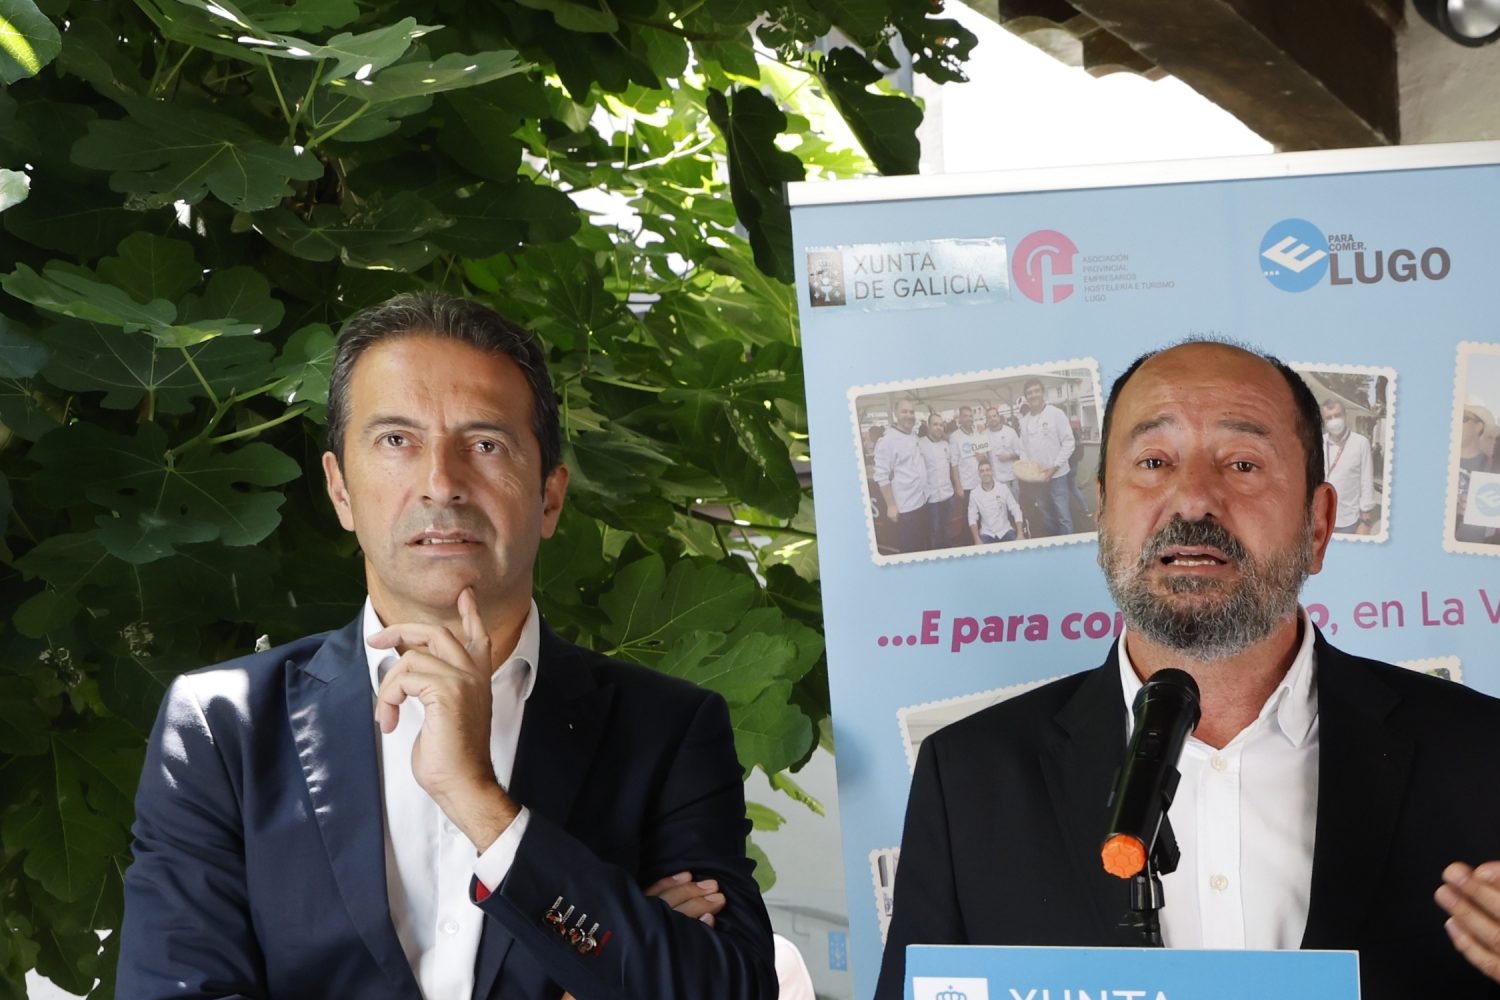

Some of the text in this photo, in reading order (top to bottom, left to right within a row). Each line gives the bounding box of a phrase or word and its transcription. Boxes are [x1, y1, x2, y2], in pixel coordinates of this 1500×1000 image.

[1328, 234, 1354, 243] PARA
[852, 252, 936, 275] XUNTA
[1329, 247, 1451, 286] LUGO
[854, 274, 990, 300] DE GALICIA
[951, 614, 1049, 653] para
[1353, 599, 1405, 629] en
[1421, 591, 1465, 627] La
